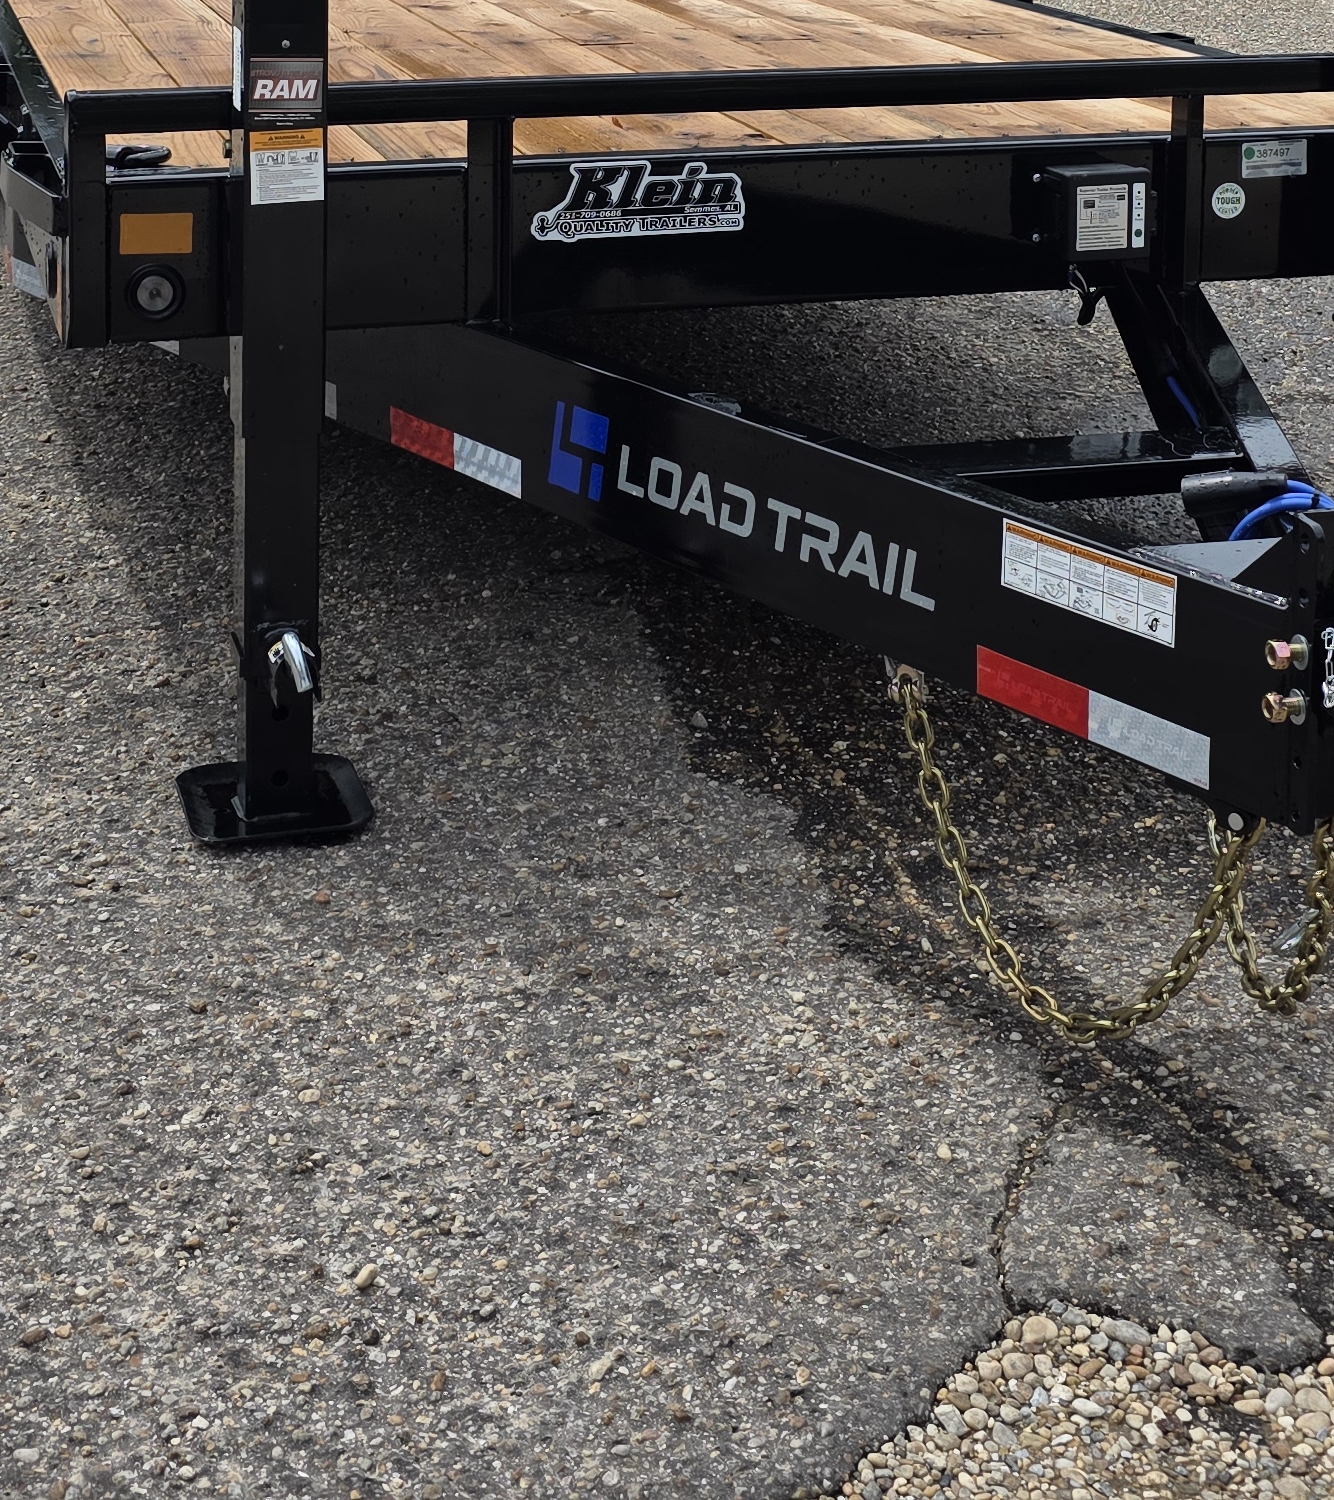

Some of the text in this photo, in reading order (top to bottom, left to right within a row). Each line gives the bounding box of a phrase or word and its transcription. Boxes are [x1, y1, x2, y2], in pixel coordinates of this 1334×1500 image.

[253, 79, 318, 99] RAM
[563, 164, 738, 211] Klein
[1215, 196, 1241, 205] TOUGH
[558, 220, 634, 238] QUALITY
[617, 444, 756, 538] LOAD
[767, 497, 936, 612] TRAIL
